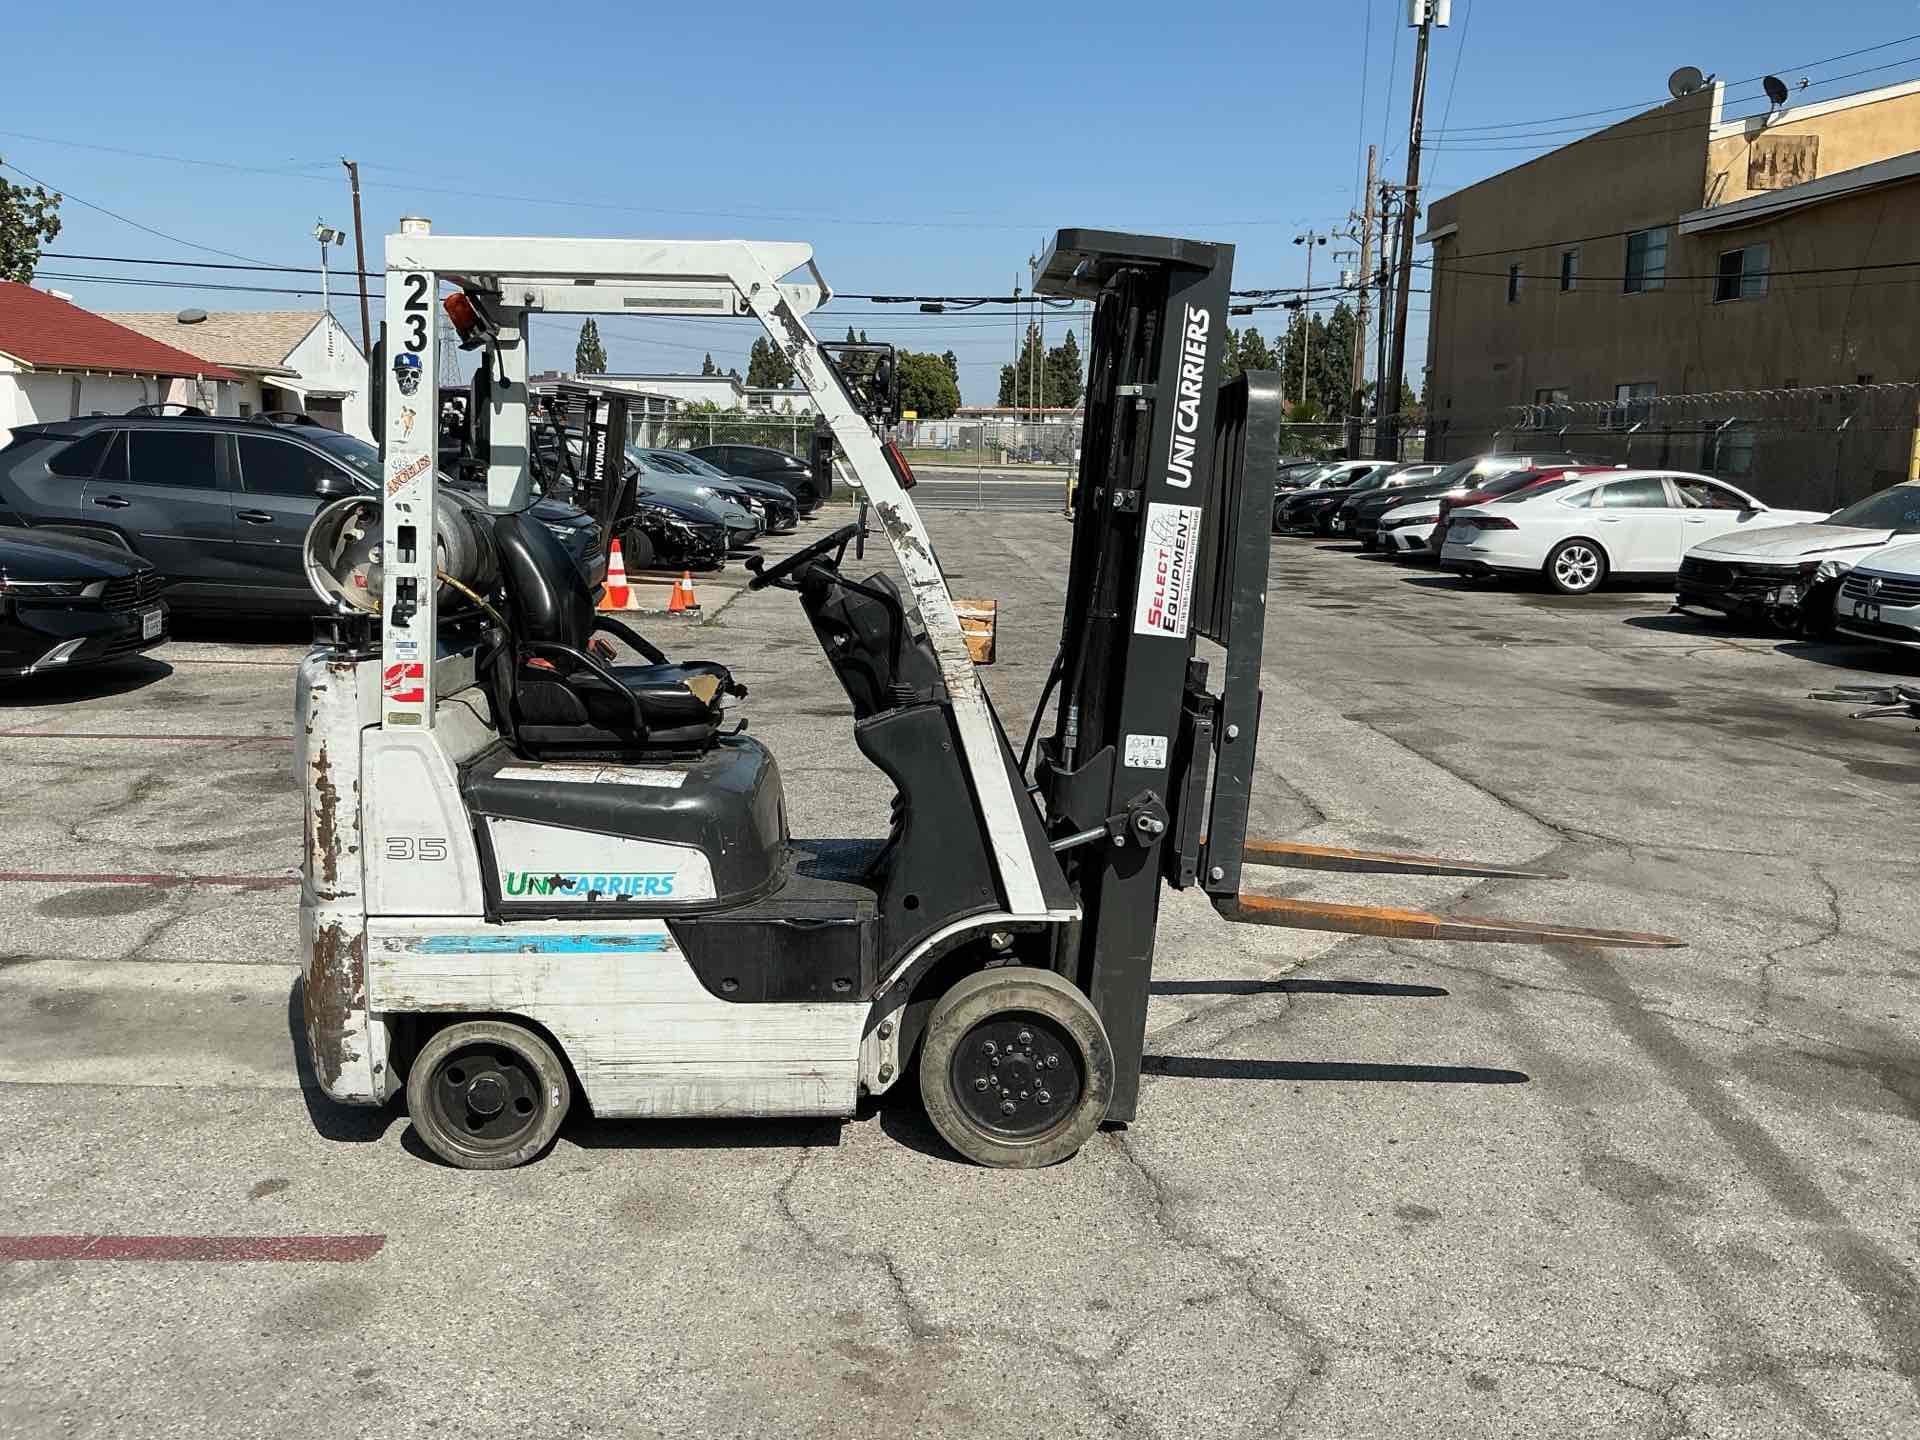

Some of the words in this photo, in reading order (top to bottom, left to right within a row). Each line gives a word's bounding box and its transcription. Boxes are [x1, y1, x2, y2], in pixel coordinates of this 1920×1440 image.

[1166, 304, 1210, 489] UNICARRIERS
[594, 430, 607, 480] HYUNDAI
[1147, 549, 1169, 628] SELECT
[1162, 509, 1189, 632] EQUIPMENT
[386, 837, 447, 861] 35
